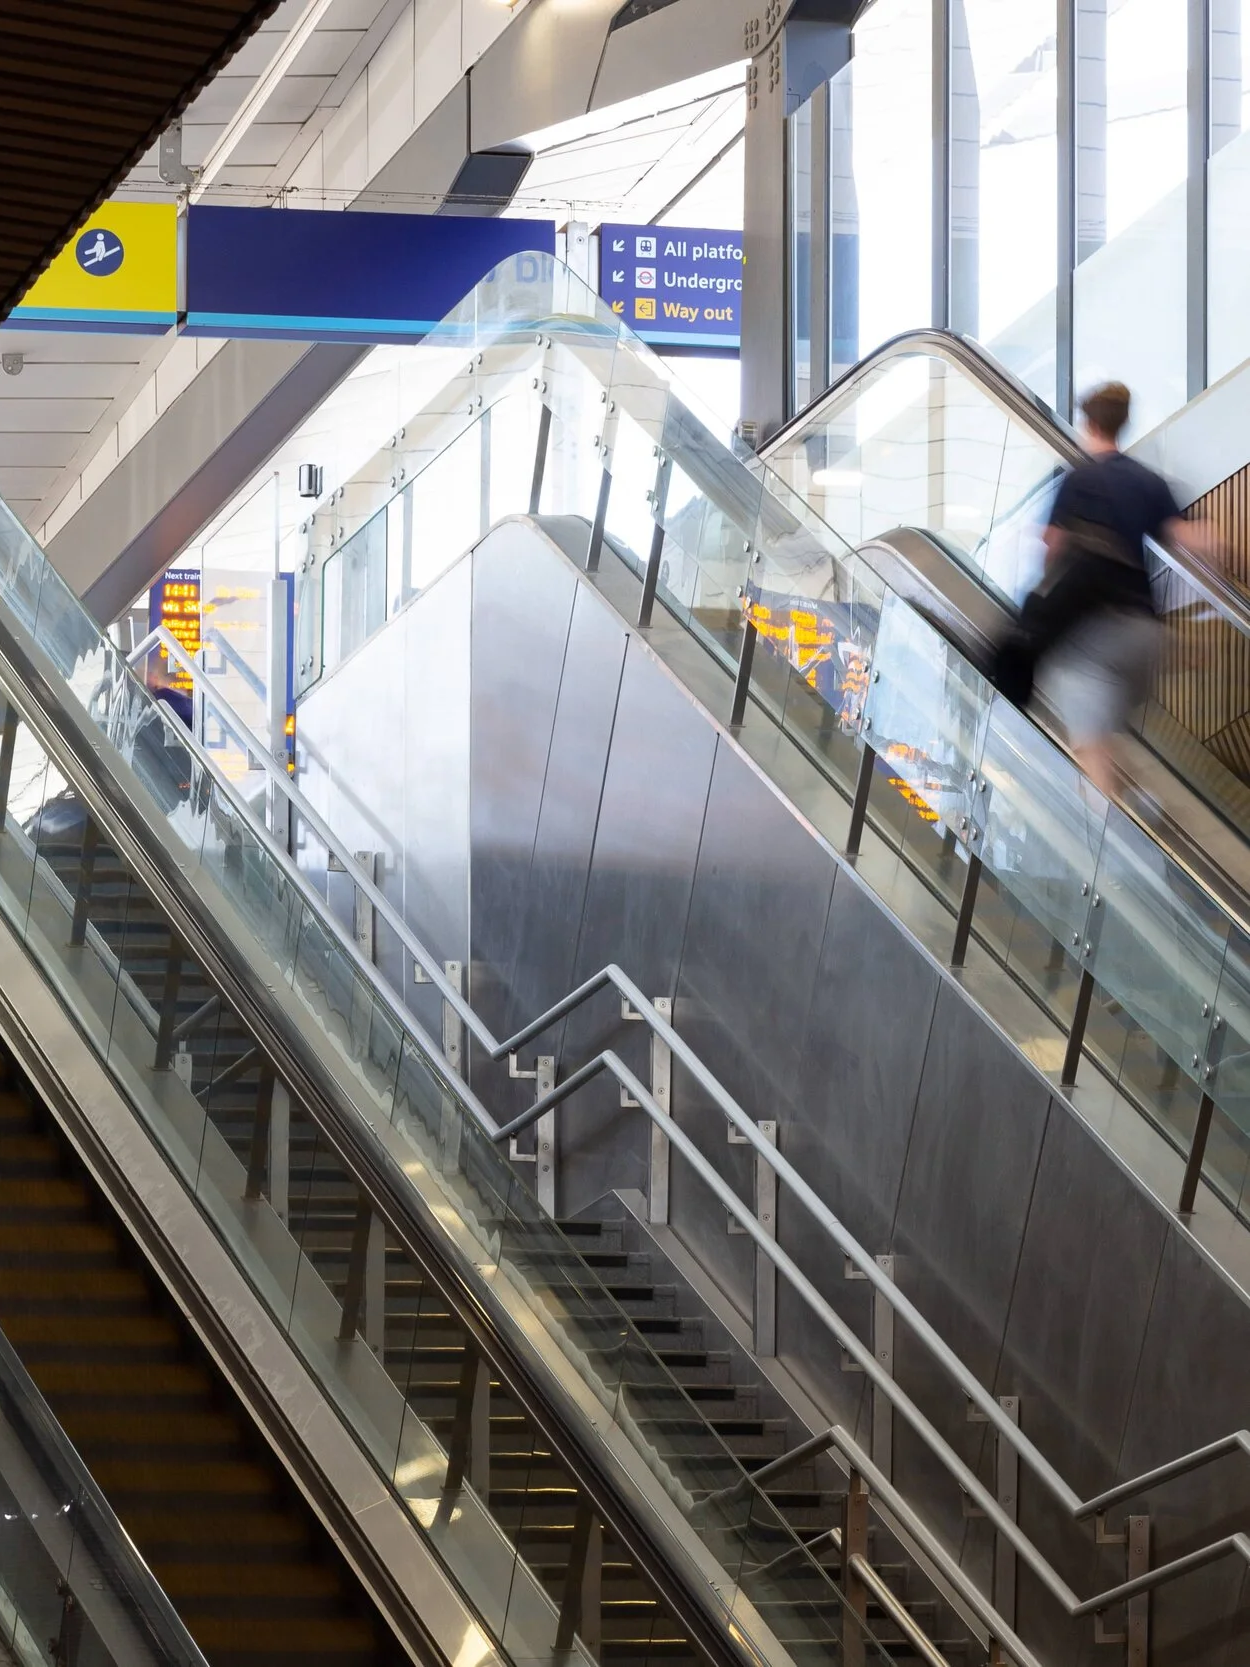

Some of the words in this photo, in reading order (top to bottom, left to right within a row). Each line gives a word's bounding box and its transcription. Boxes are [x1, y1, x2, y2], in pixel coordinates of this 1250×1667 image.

[663, 241, 687, 257] All
[692, 242, 744, 261] platfo
[664, 271, 743, 294] Undergro
[662, 302, 700, 323] Way
[703, 306, 734, 321] out
[165, 571, 183, 580] Next
